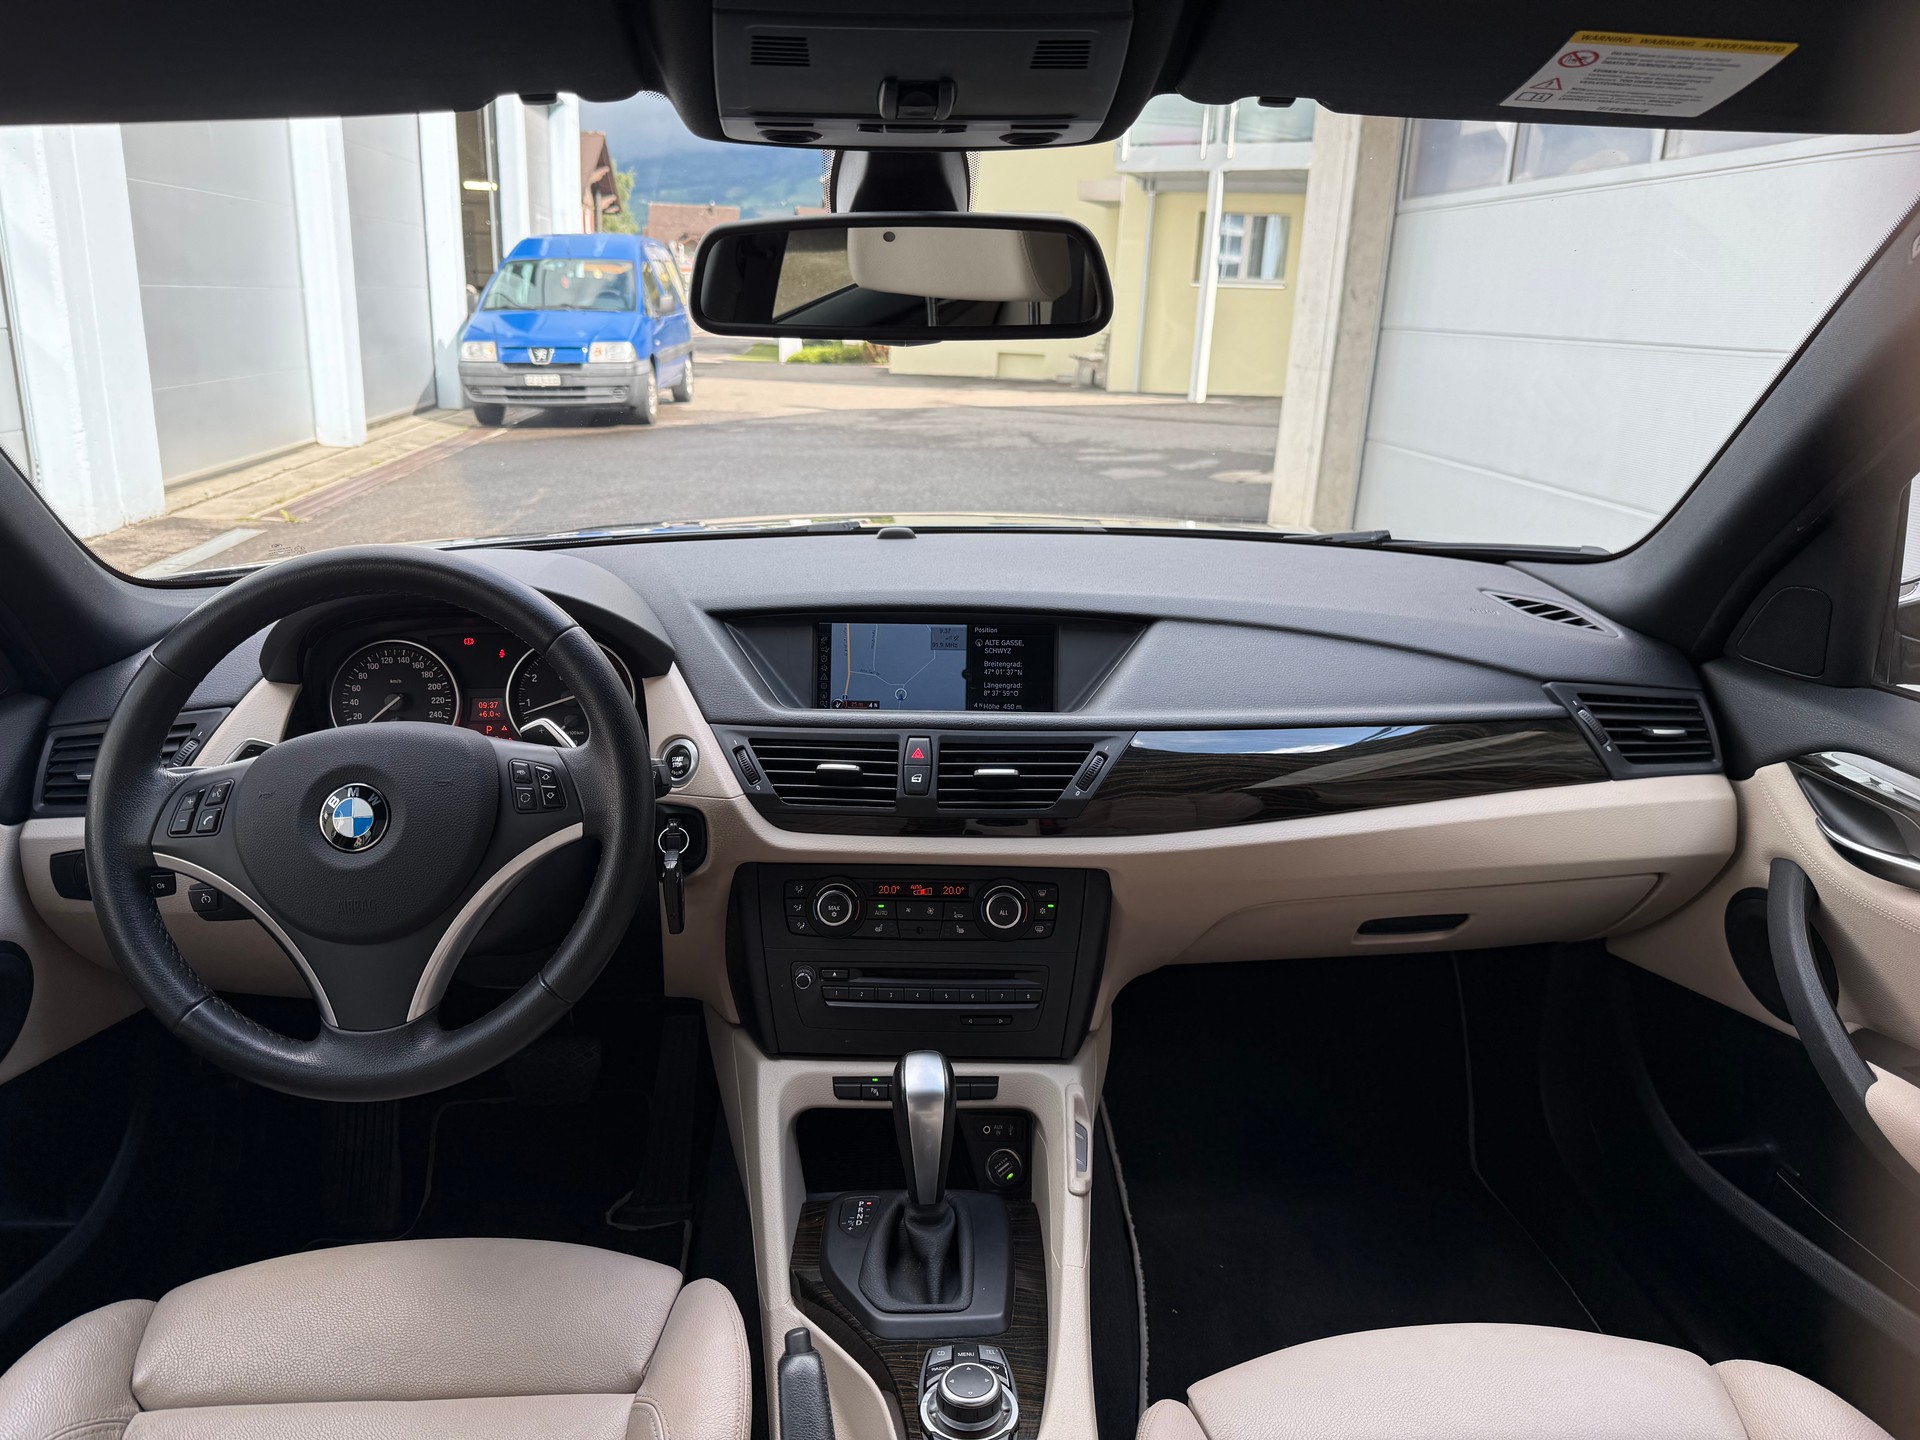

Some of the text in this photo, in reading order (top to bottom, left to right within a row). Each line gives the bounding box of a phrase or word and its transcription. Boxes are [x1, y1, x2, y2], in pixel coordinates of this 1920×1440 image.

[1581, 34, 1786, 52] WARNING WARNUNG AVVERTIMENTO
[1001, 639, 1025, 647] GASSE,
[367, 662, 379, 670] 100
[983, 660, 1023, 668] Breitengrad:
[531, 673, 538, 682] 2
[486, 725, 493, 734] P
[327, 787, 381, 809] BMW
